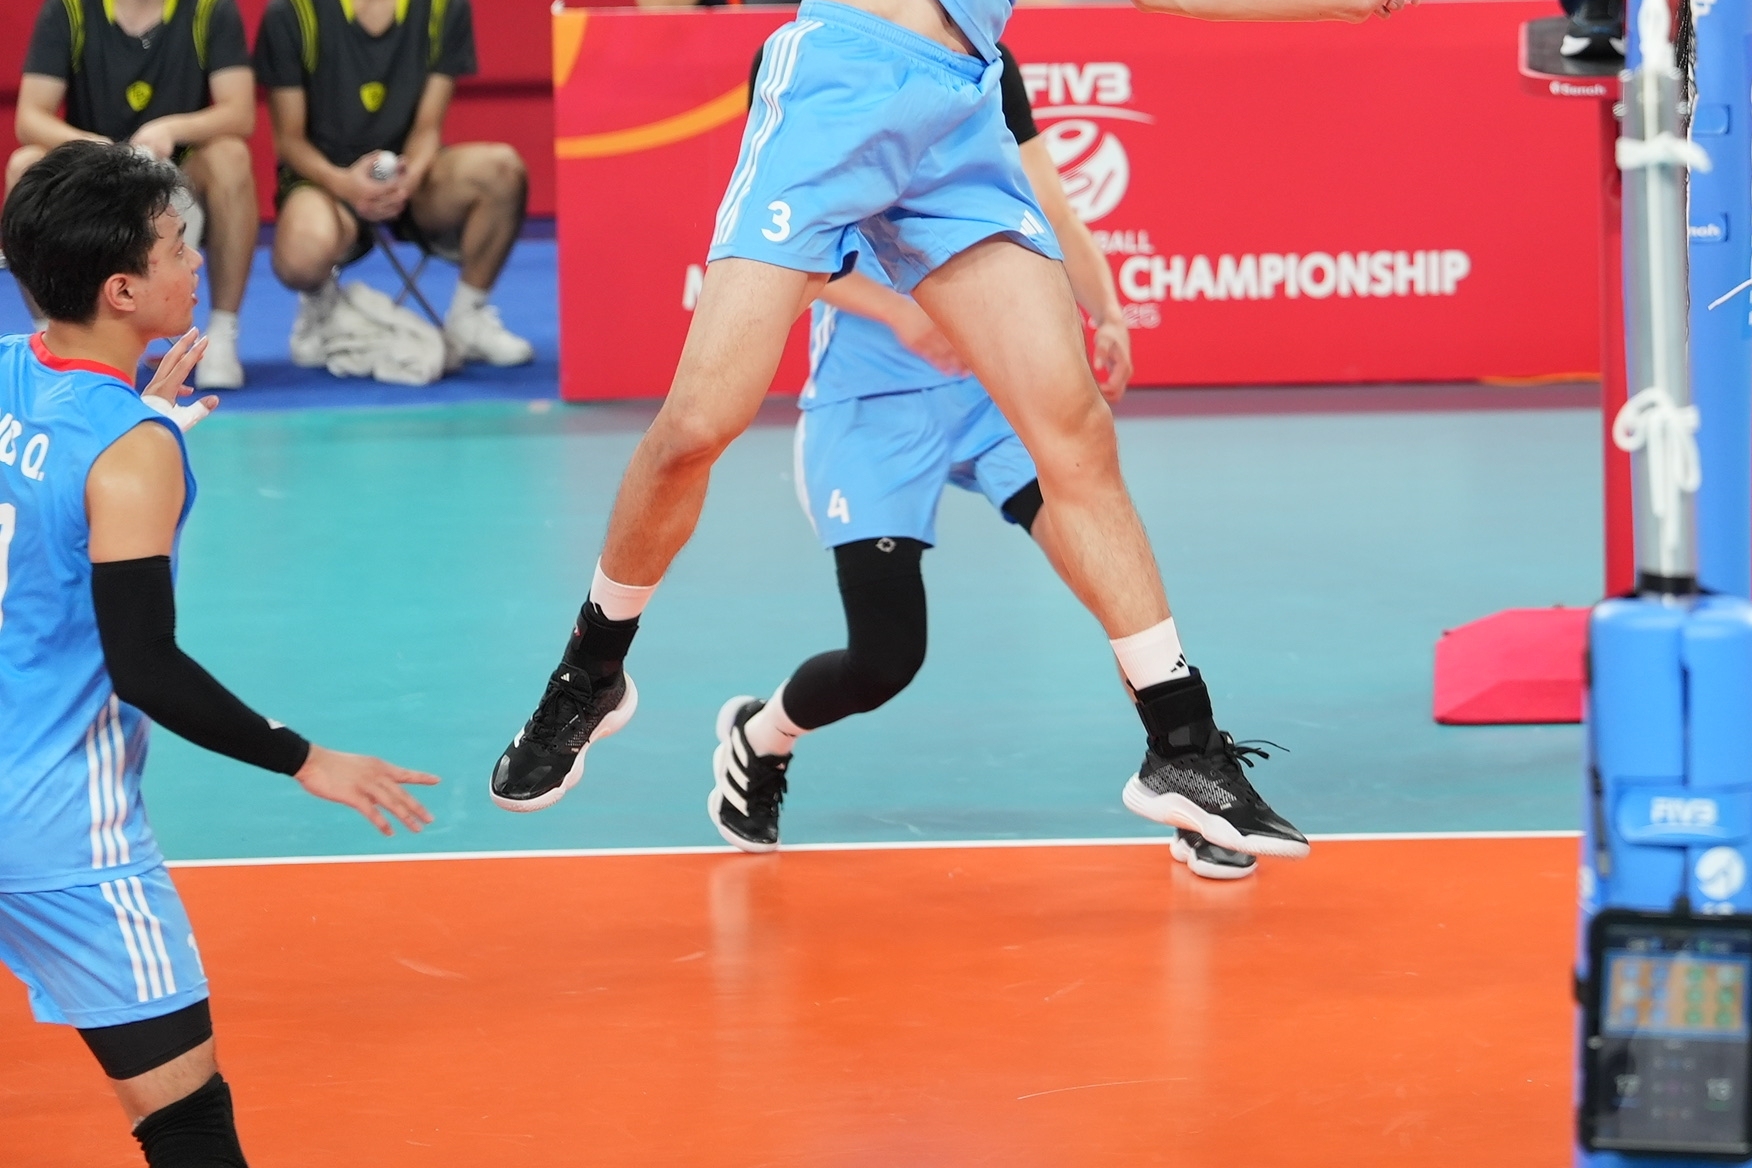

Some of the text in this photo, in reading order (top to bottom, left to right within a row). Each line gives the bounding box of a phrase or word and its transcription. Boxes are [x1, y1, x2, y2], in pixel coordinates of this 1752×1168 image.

[1022, 62, 1132, 105] FIVB
[761, 200, 792, 243] 3
[1118, 249, 1471, 303] CHAMPIONSHIP
[827, 489, 850, 524] 4
